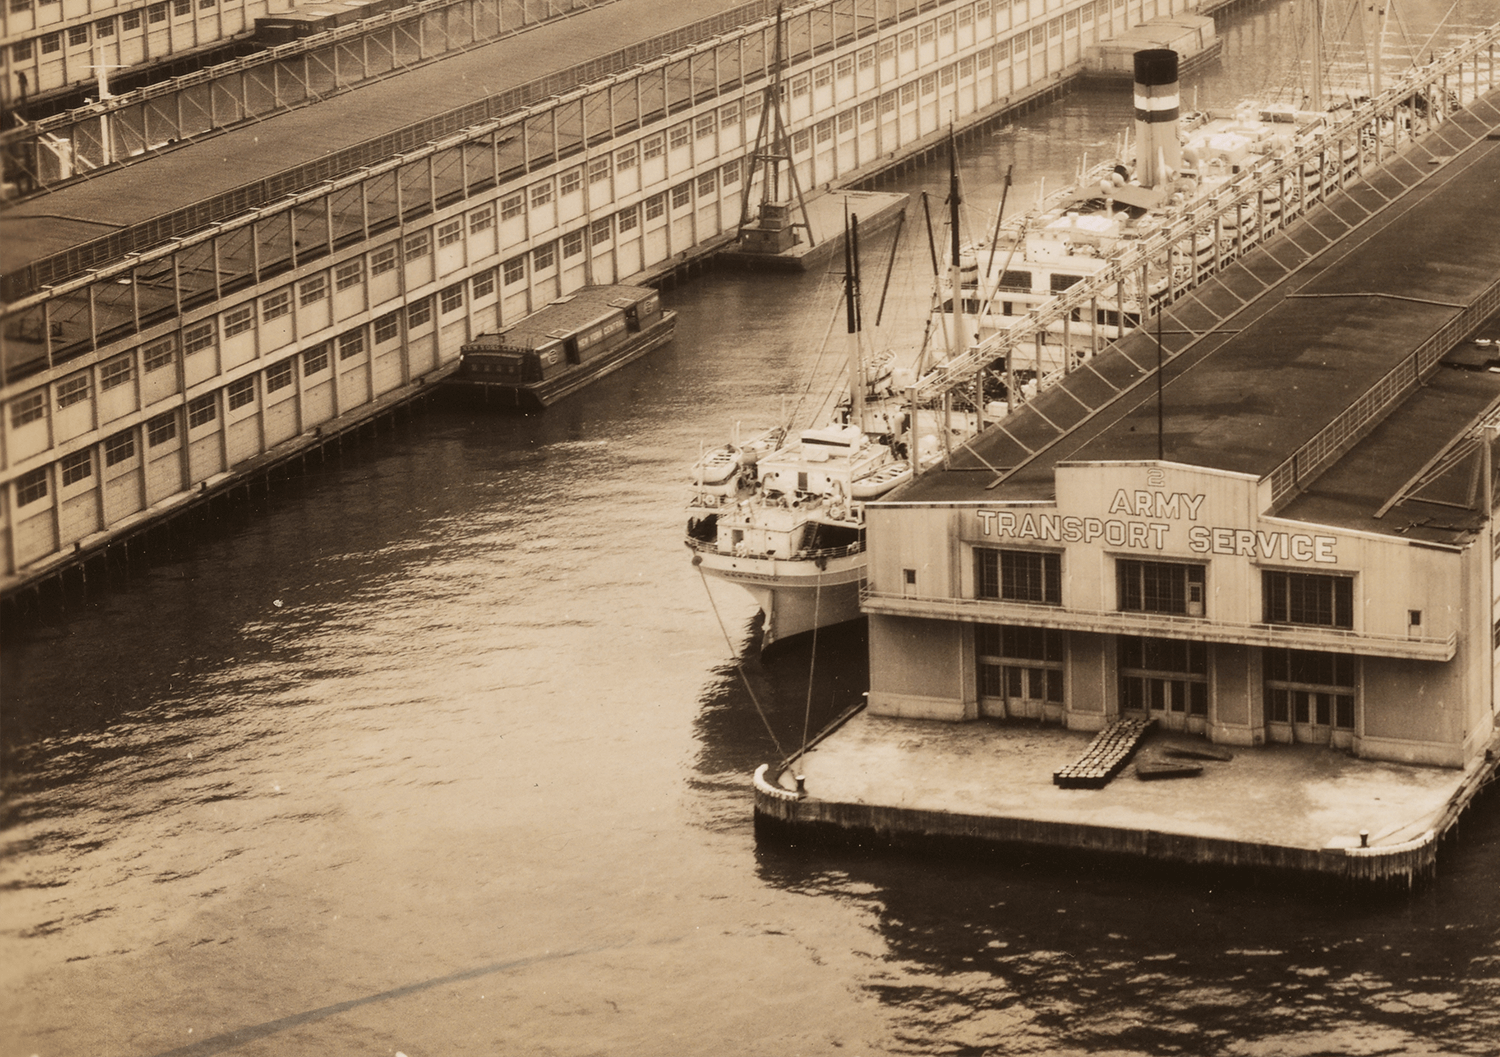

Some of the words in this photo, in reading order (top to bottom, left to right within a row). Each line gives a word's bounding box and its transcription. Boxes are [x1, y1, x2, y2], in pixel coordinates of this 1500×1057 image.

[1146, 467, 1165, 487] 2
[1108, 488, 1206, 521] ARMY
[977, 510, 1170, 551] TRANSPORT
[1188, 526, 1338, 564] SERVICE
